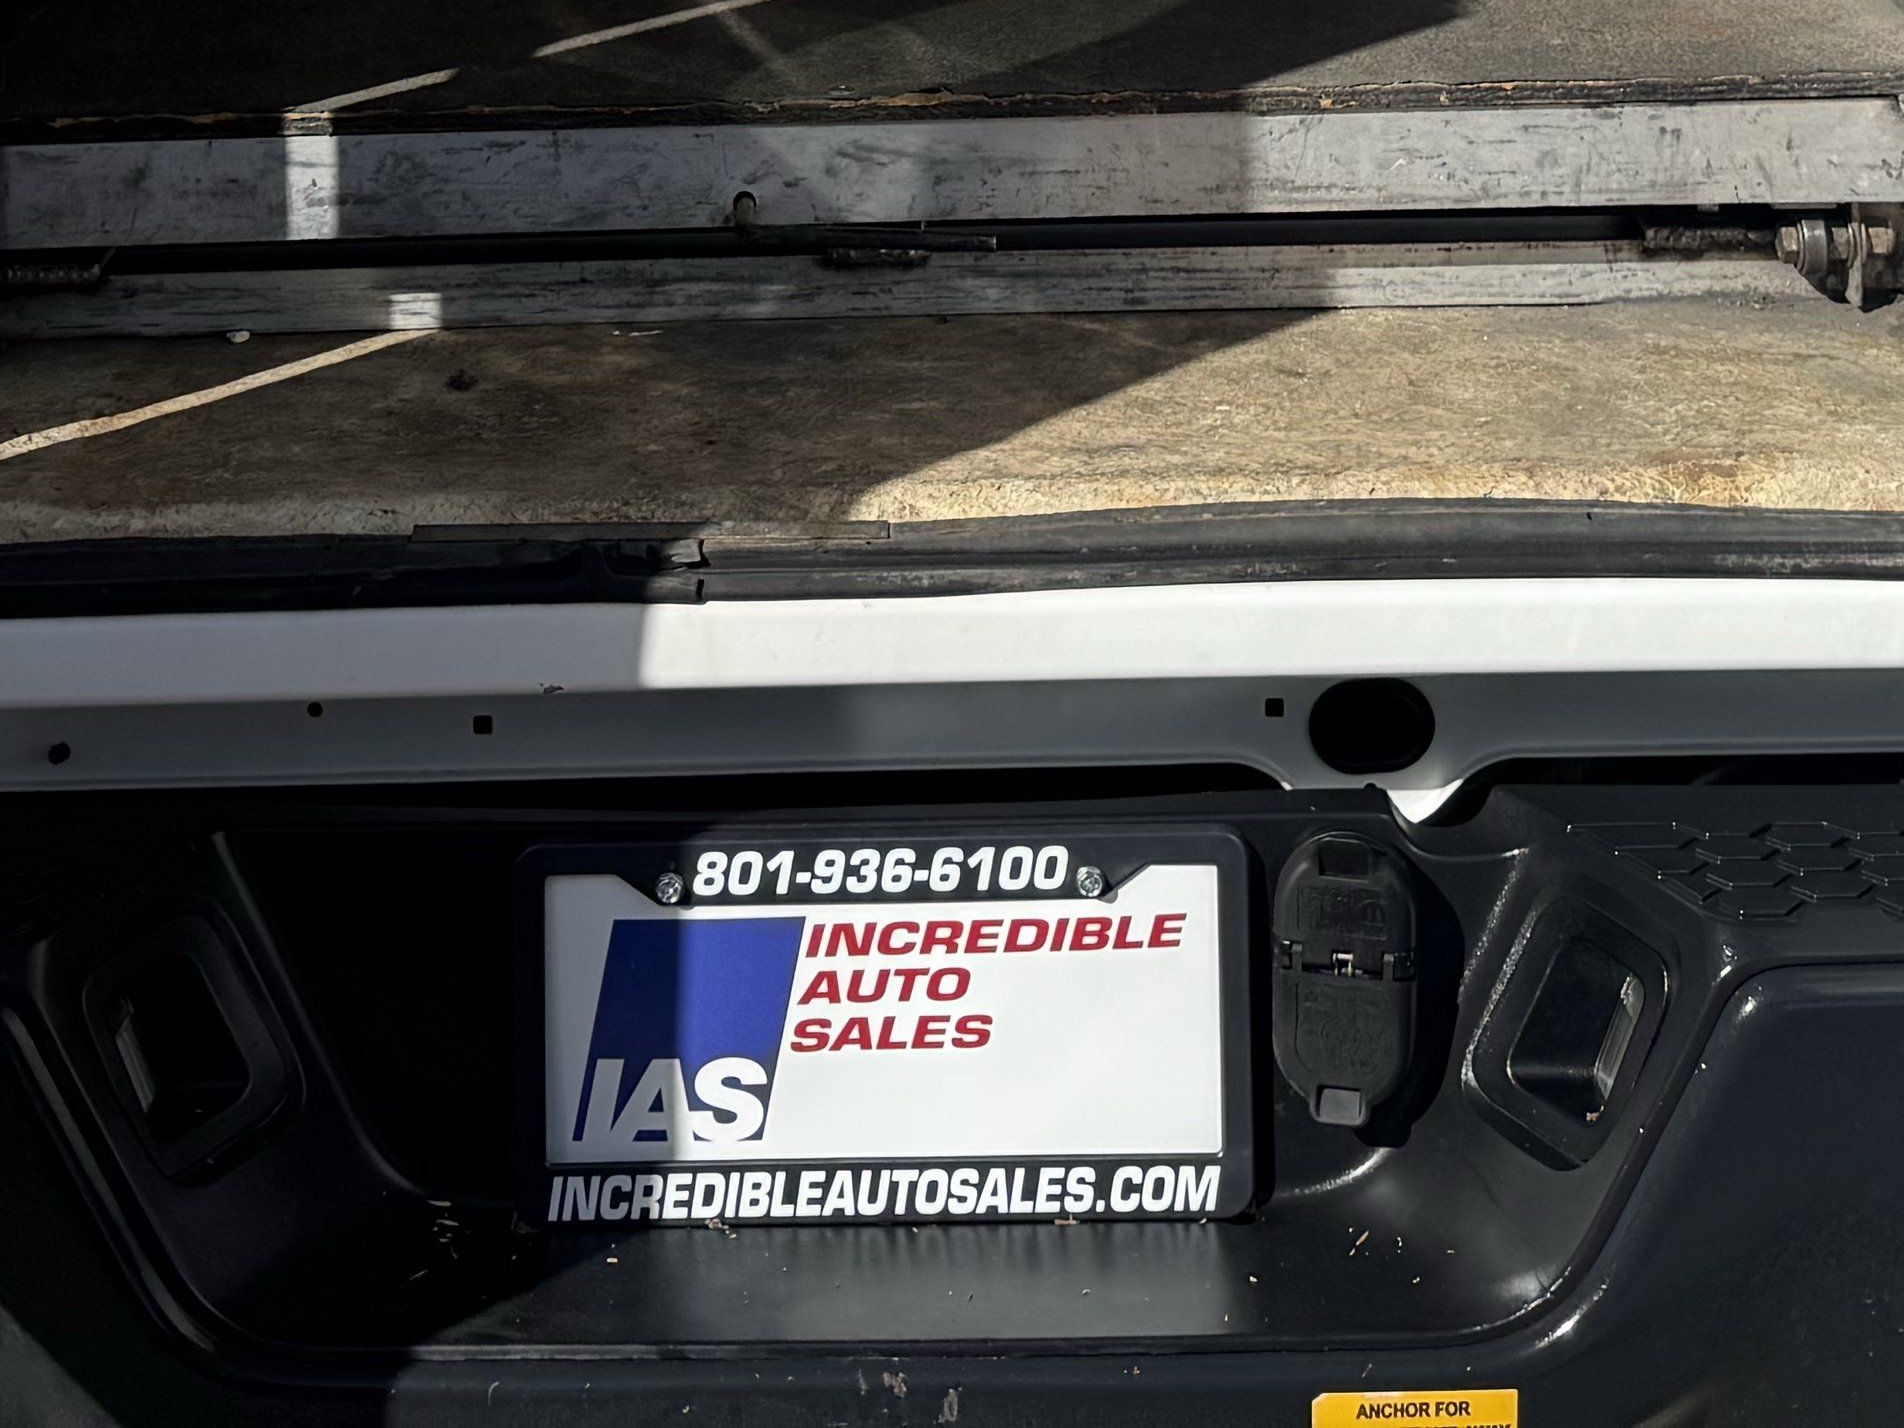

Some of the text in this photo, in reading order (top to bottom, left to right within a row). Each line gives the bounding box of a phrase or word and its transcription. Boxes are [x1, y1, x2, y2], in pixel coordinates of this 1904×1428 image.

[692, 845, 1069, 896] 801-936-6100
[805, 913, 1187, 958] INCREDIBLE
[797, 967, 971, 1005] AUTO
[790, 1014, 994, 1052] SALES
[581, 1056, 768, 1142] IAS
[548, 1165, 1222, 1222] INCREDIBLEAUTOSALES.COM
[1355, 1400, 1471, 1420] ANCHOR FOR
